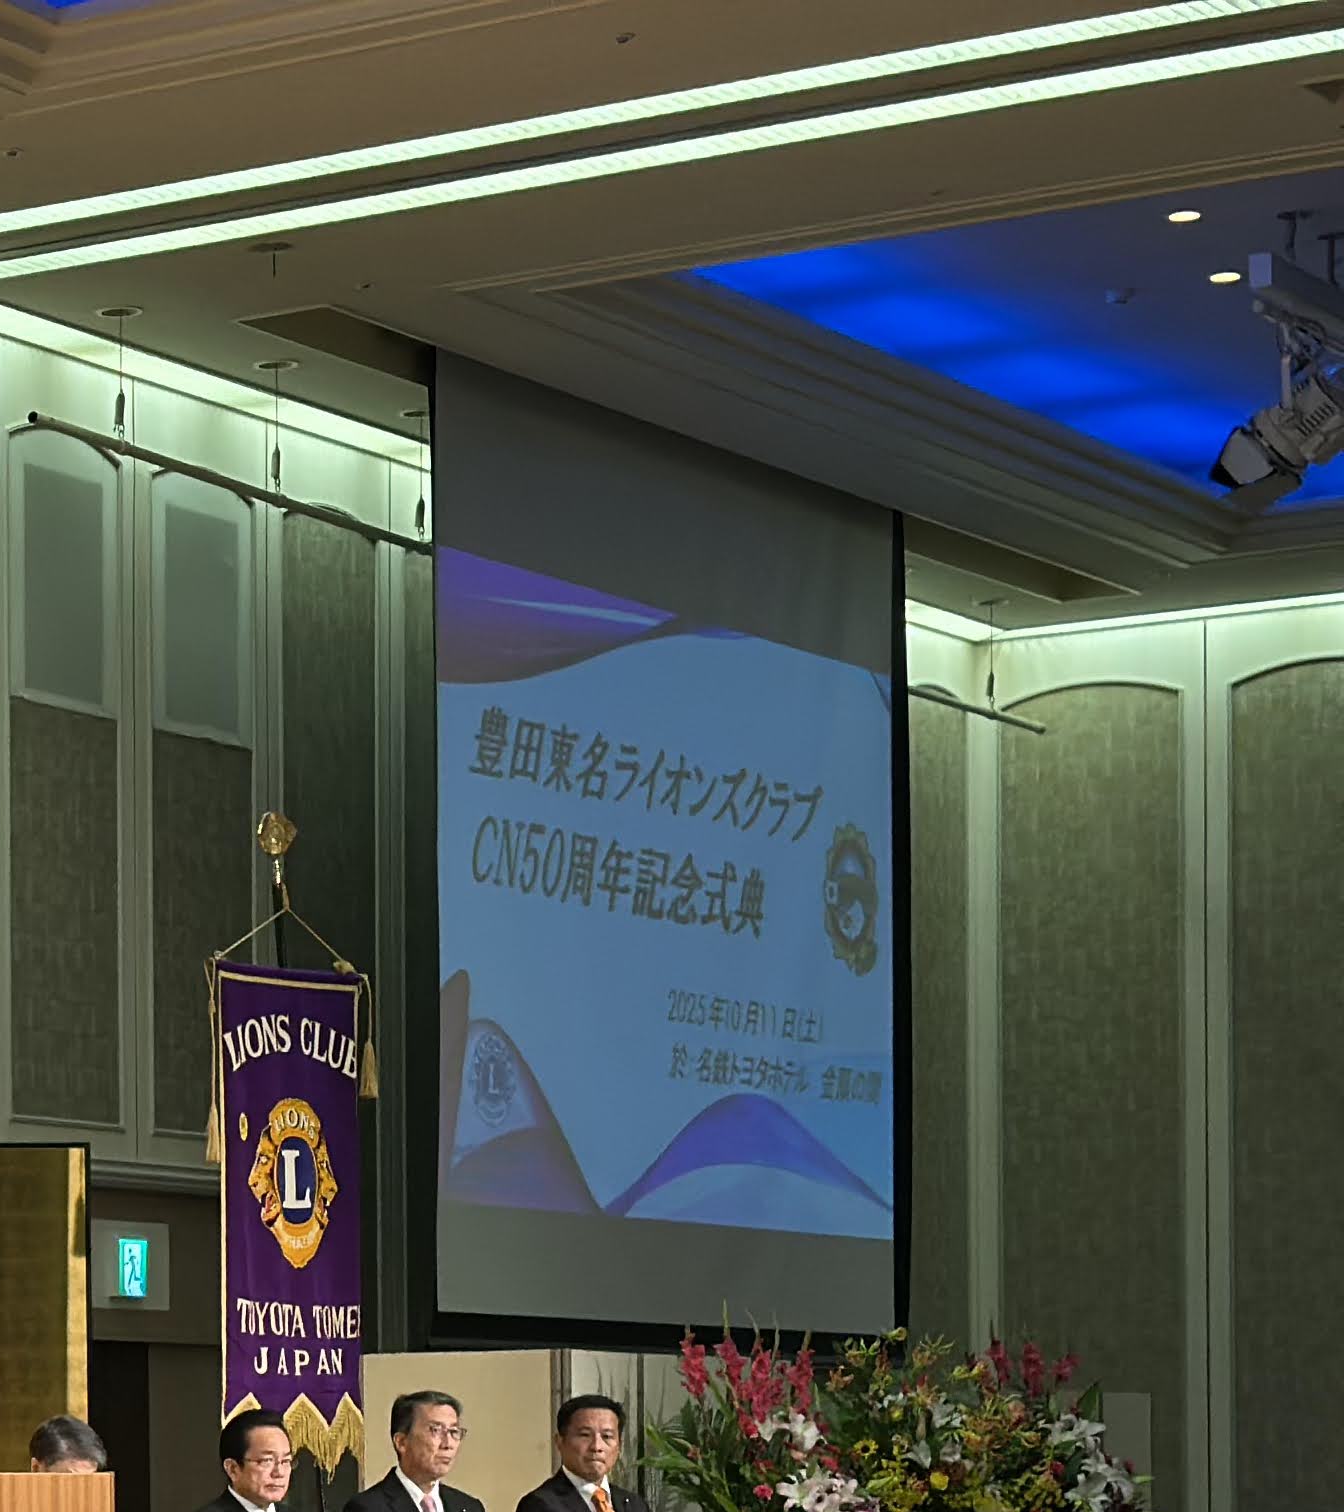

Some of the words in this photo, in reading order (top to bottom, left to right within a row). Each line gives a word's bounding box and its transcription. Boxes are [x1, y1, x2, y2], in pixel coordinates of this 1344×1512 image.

[472, 816, 766, 940] CN50周年記念式典
[223, 1014, 292, 1072] LIONS
[300, 1017, 358, 1080] CLUB
[274, 1107, 316, 1138] LIONS
[281, 1149, 312, 1210] L
[237, 1298, 306, 1338] TOYOTA
[254, 1346, 343, 1376] JAPAN
